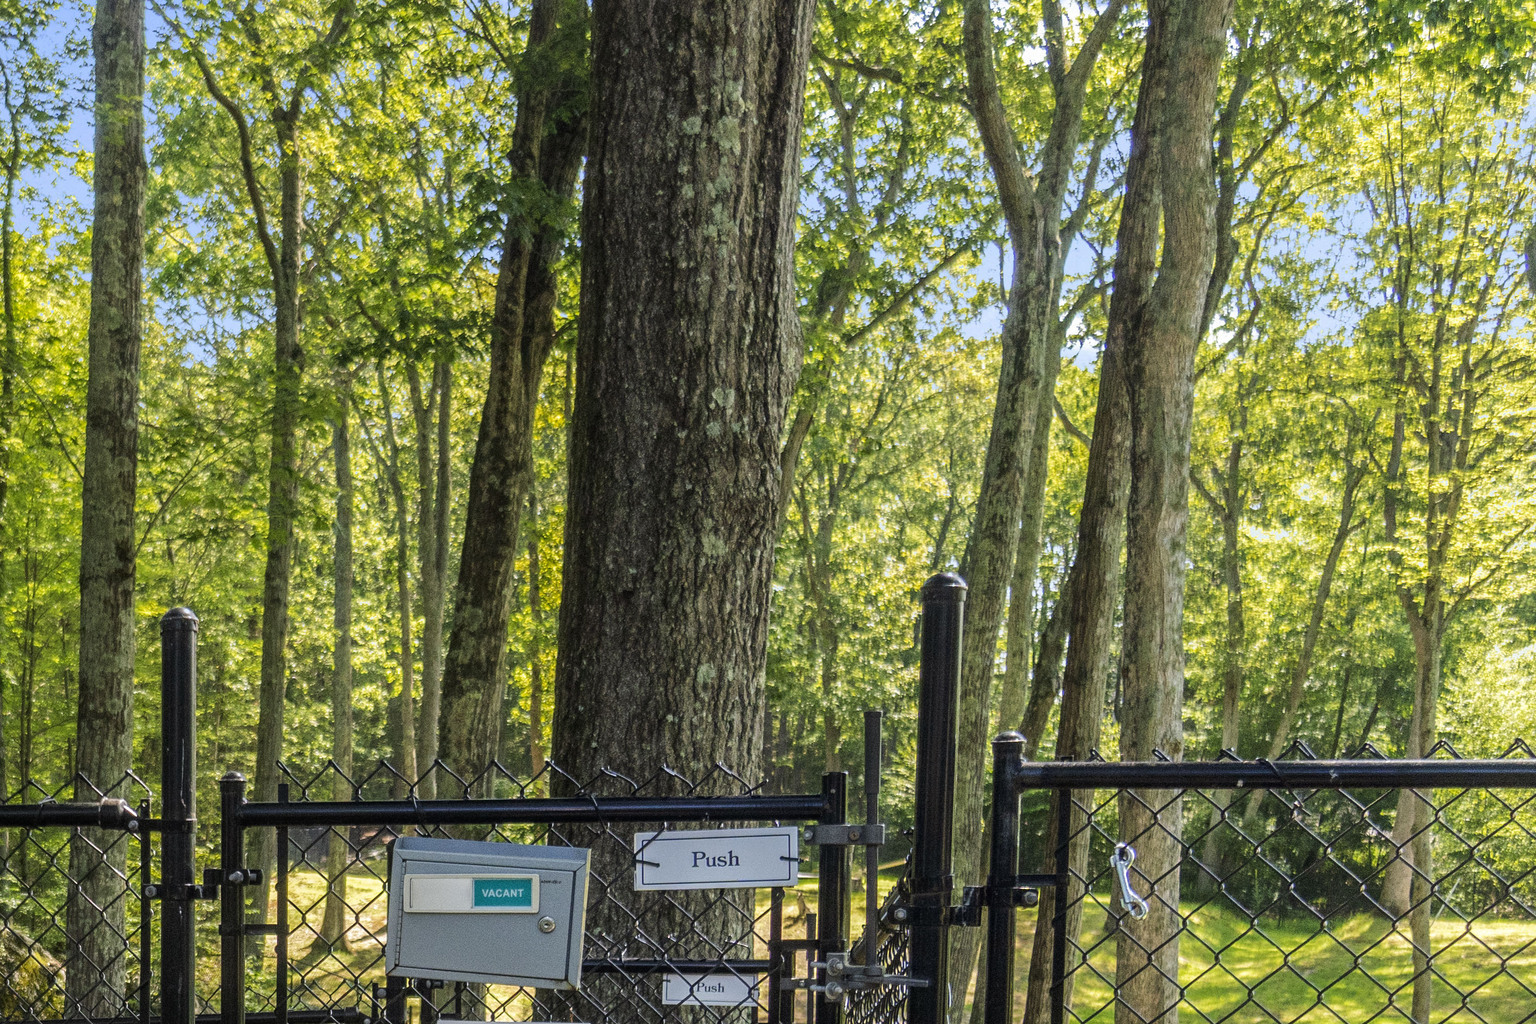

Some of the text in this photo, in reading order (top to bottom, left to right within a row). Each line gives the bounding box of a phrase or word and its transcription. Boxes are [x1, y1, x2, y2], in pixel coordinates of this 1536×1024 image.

[691, 850, 741, 869] Push
[481, 886, 525, 899] VACANT
[695, 981, 726, 994] Push
